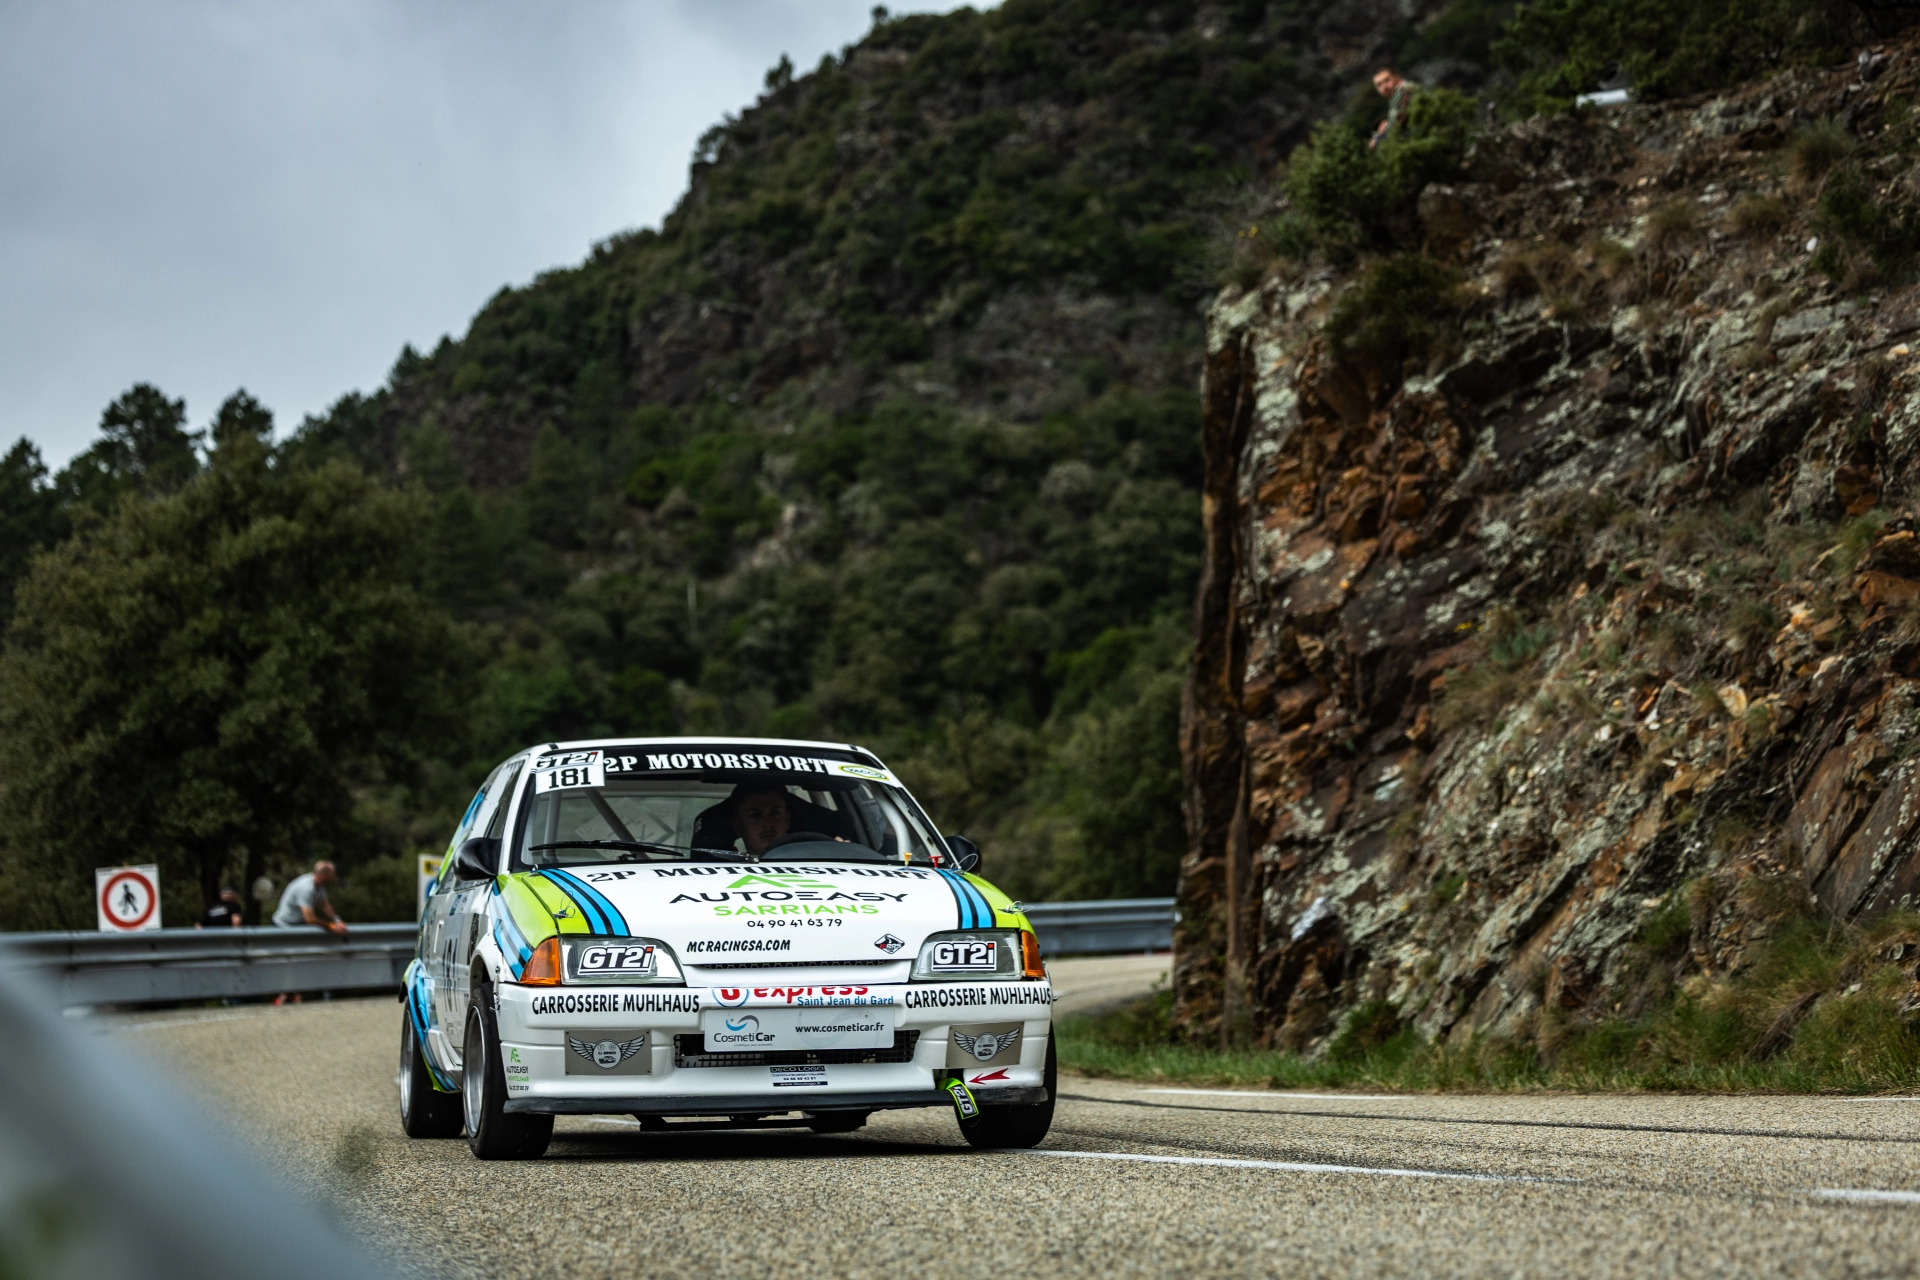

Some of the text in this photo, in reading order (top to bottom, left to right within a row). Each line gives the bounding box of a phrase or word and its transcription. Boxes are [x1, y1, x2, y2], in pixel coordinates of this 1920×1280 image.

[604, 753, 826, 773] 2P MOTORSPORT
[549, 767, 592, 789] 181
[587, 866, 931, 883] 2P MOTORSPORT
[669, 891, 909, 903] AUTOEASY
[713, 904, 879, 916] SARRIANS
[747, 918, 843, 929] 04 90 41 63 79
[582, 946, 655, 969] GT2i
[934, 942, 995, 965] GT2i
[532, 994, 700, 1015] CARROSSERIE MUHLHAUS
[797, 995, 895, 1007] Saint Jean du Gard
[905, 986, 1051, 1009] CARROSSERIE MUHLHAUS
[795, 1022, 885, 1033] www.cosmeticar.fr
